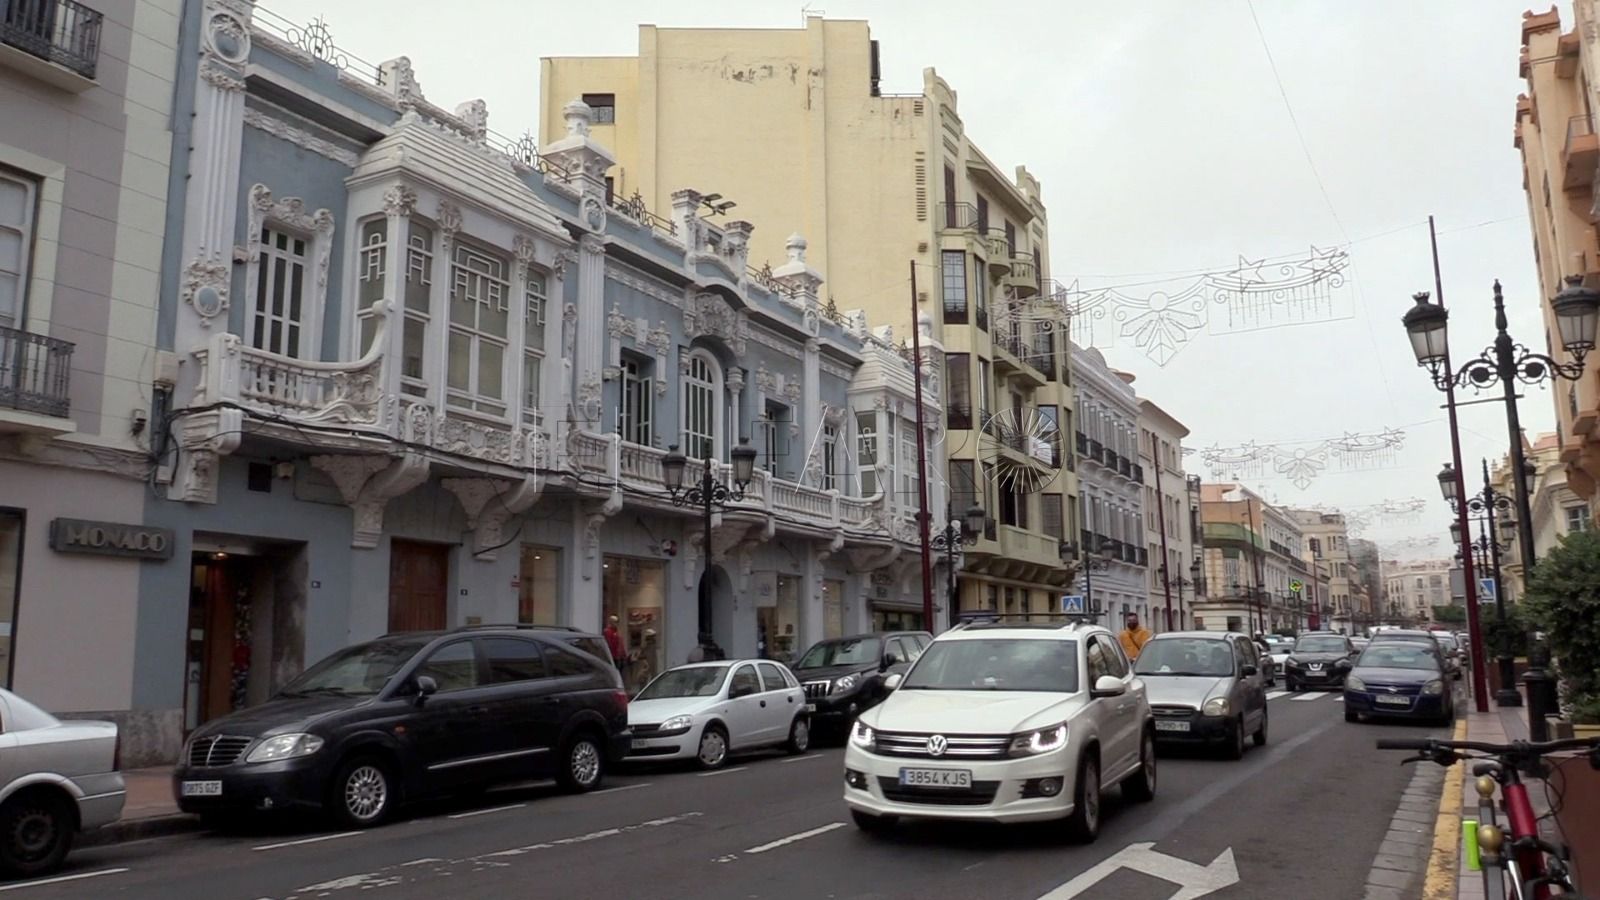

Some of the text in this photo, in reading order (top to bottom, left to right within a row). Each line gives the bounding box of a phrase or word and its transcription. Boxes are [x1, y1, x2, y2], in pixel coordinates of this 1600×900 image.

[65, 525, 166, 552] MONACO
[907, 770, 968, 786] 3854 KJS
